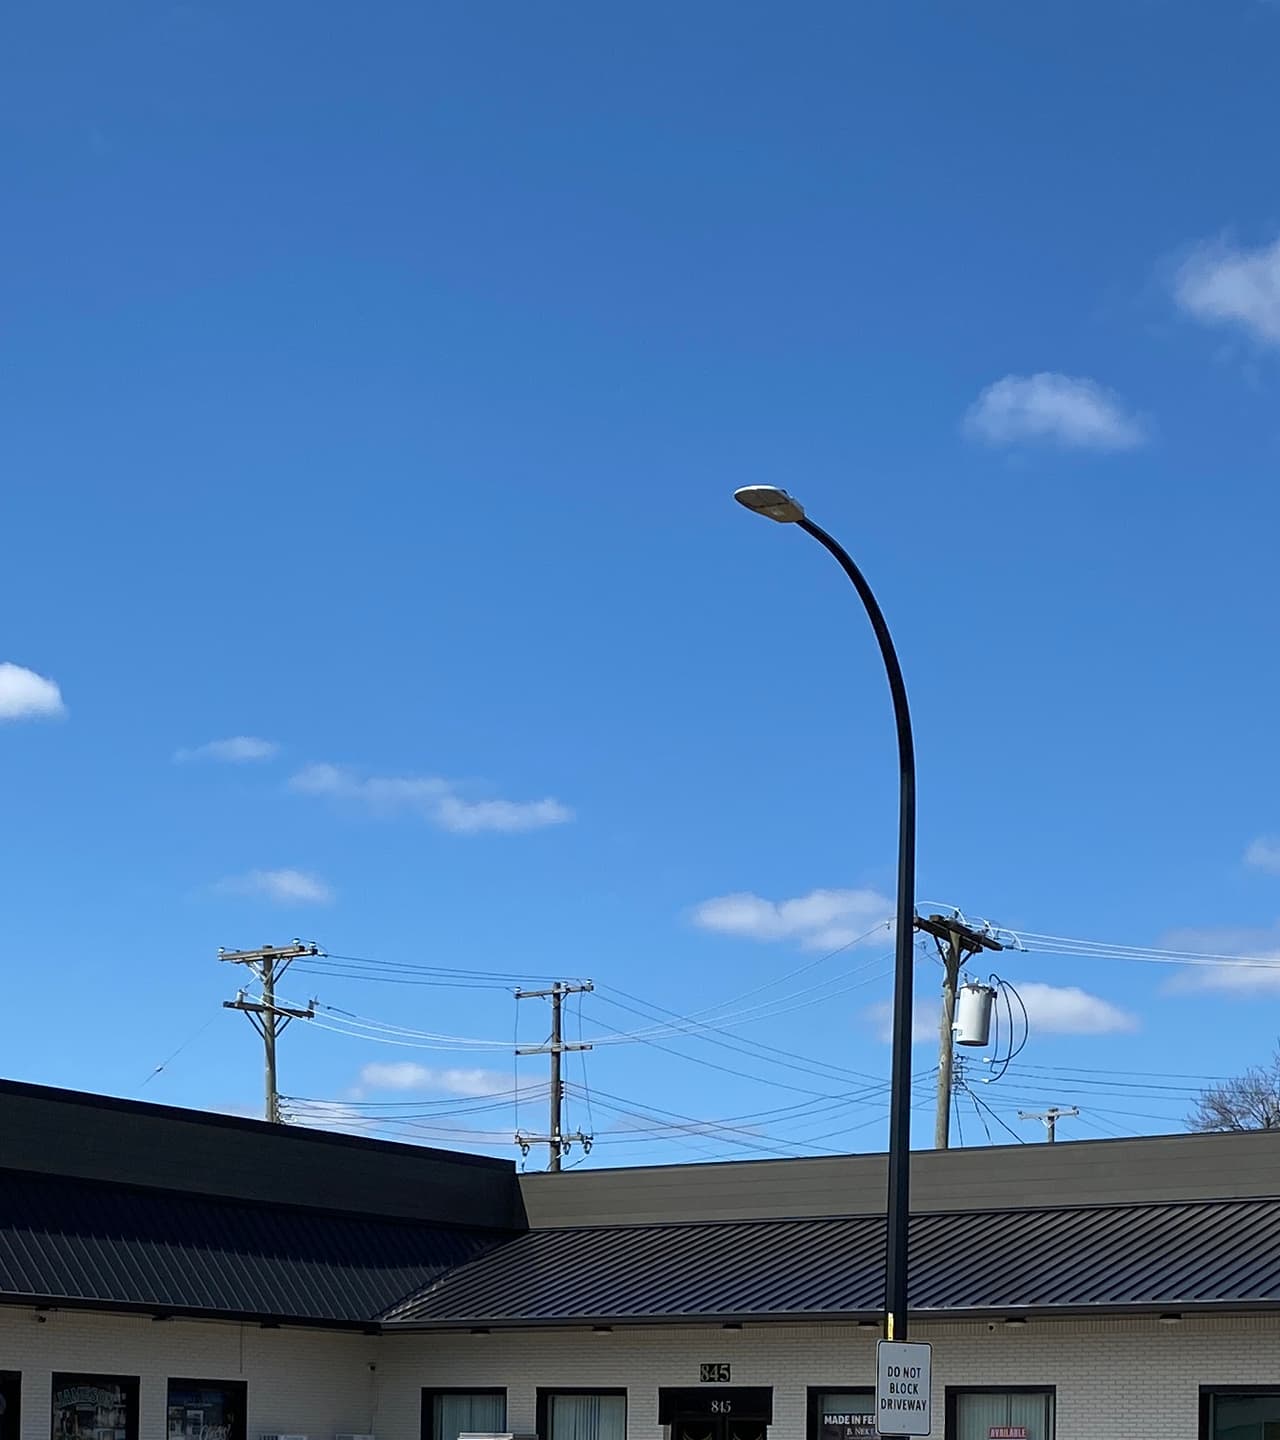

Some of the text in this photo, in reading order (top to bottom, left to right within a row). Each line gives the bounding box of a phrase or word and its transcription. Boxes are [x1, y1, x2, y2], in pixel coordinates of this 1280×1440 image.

[701, 1364, 730, 1381] 845
[887, 1366, 922, 1378] DO NOT
[889, 1383, 919, 1394] BLOCK
[880, 1399, 927, 1411] DRIVEWAY
[824, 1415, 850, 1424] MADE
[851, 1415, 861, 1424] IN
[990, 1428, 1026, 1438] AVAILABLE
